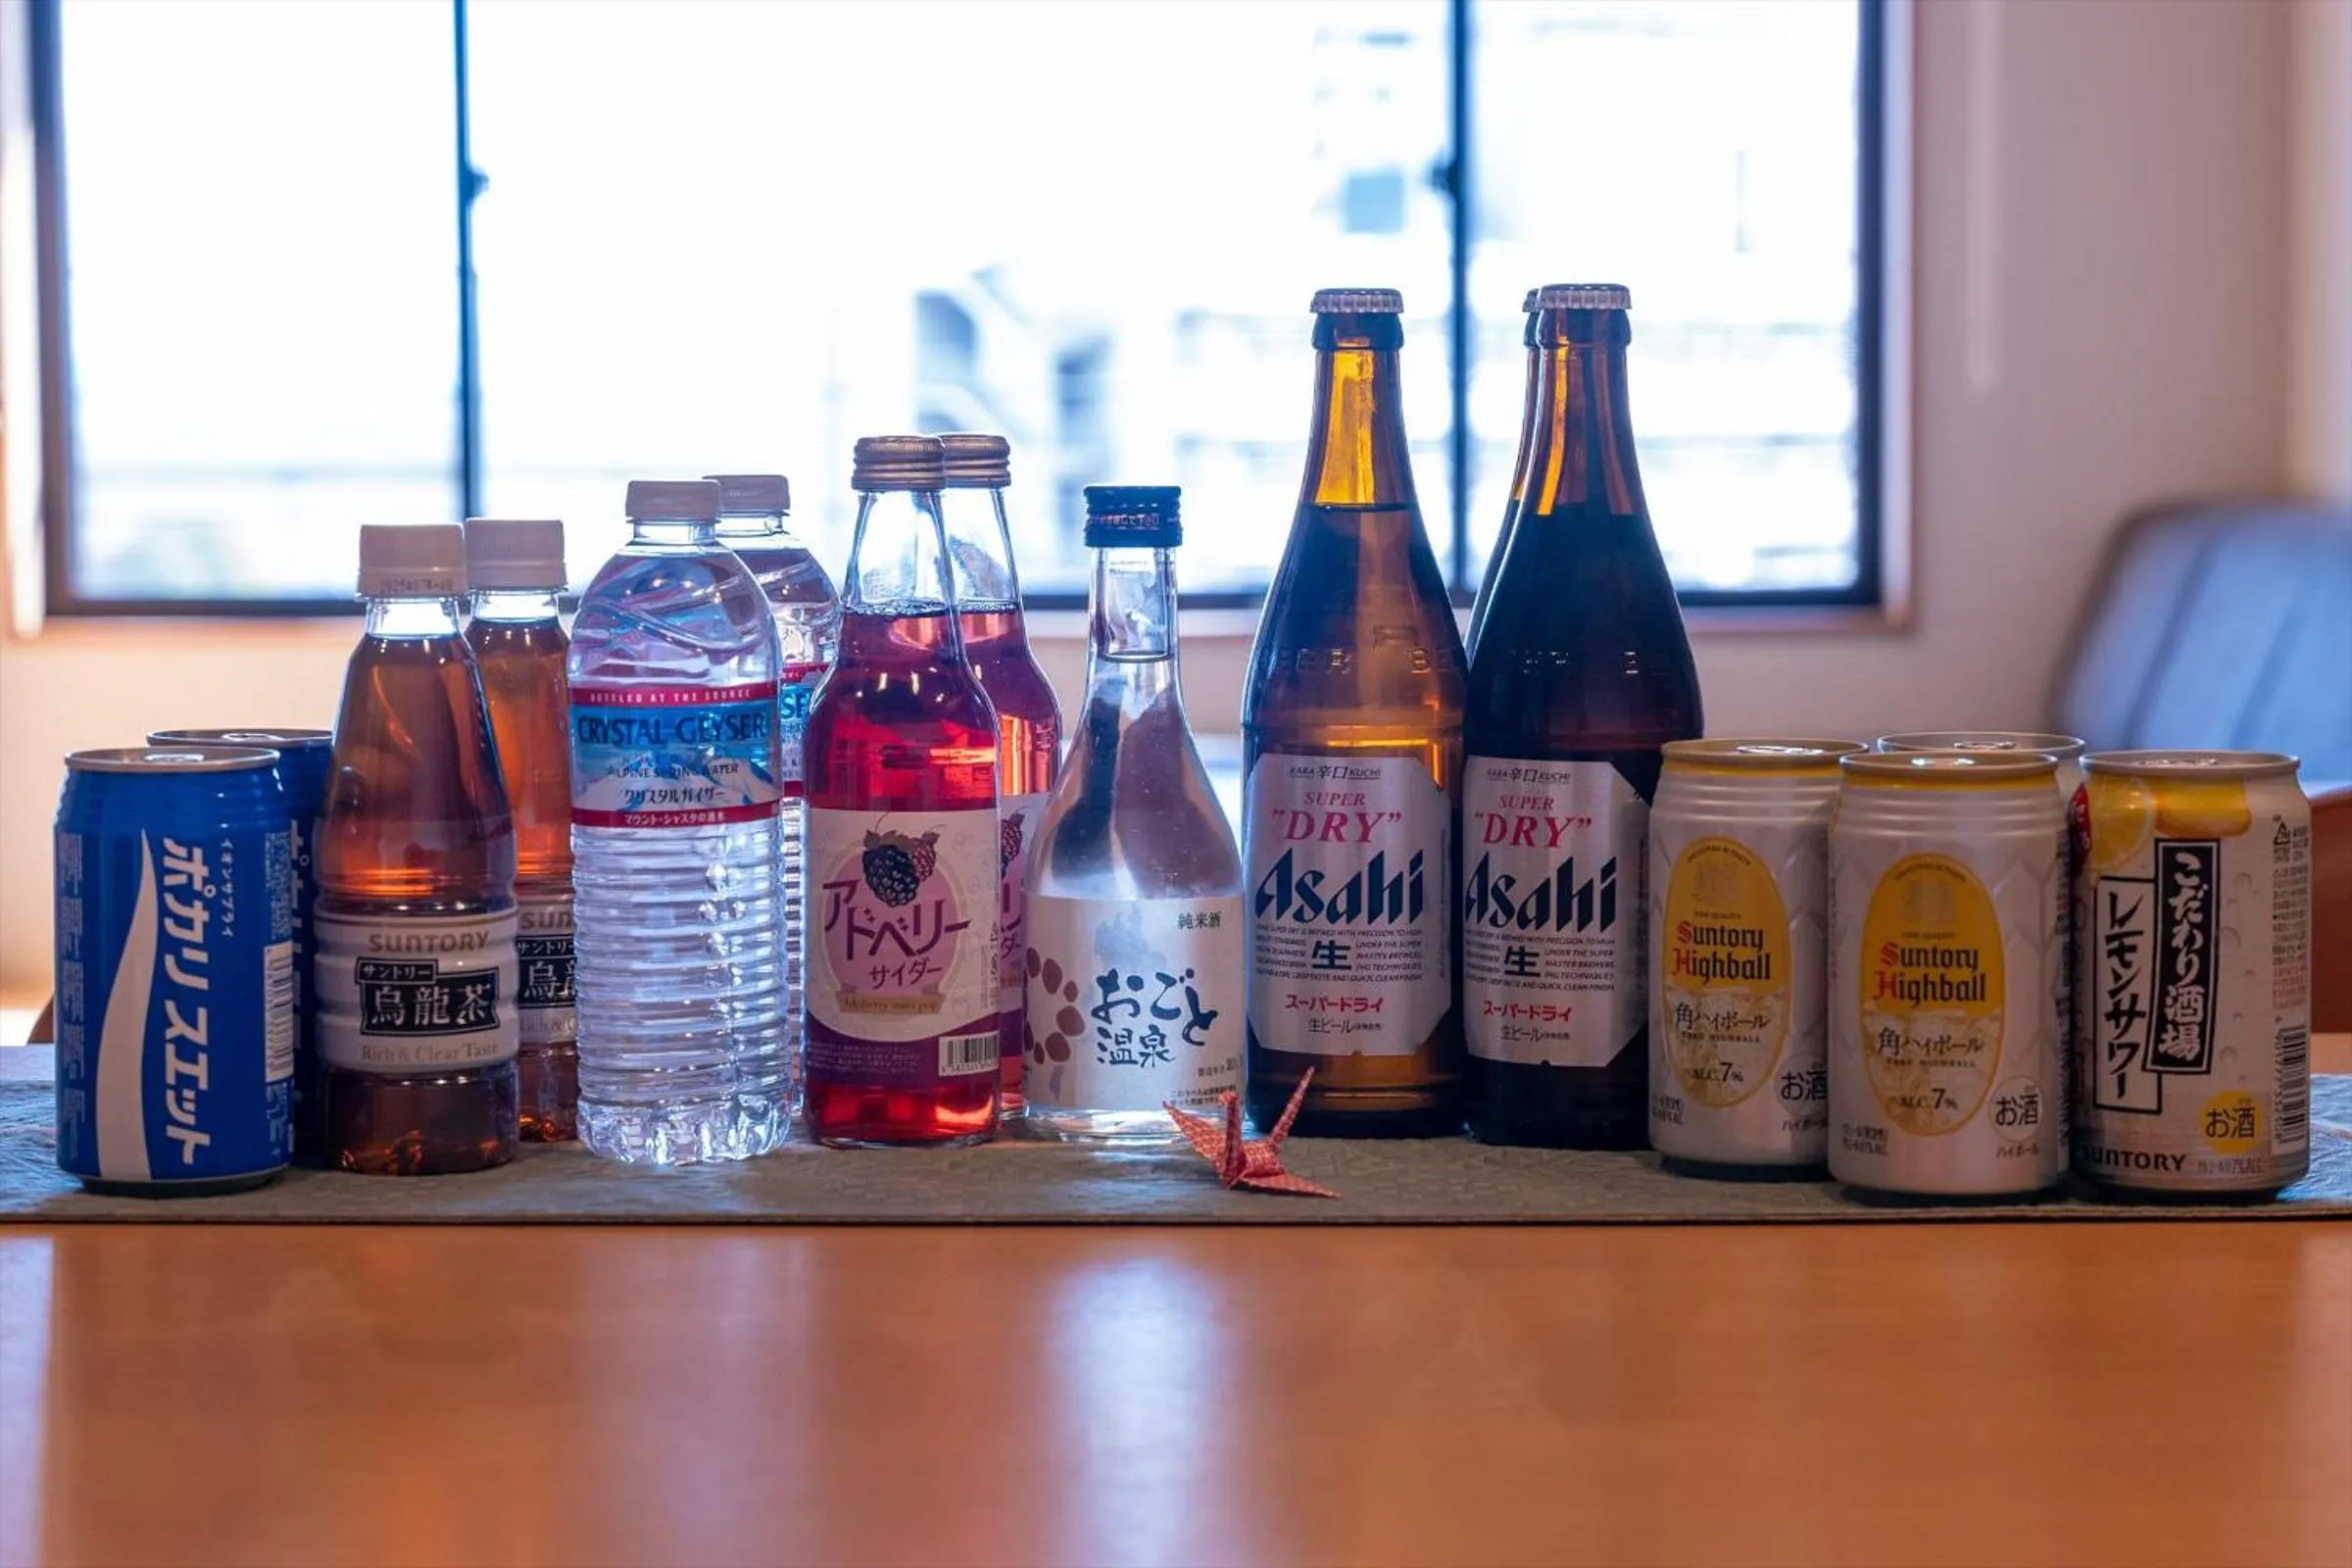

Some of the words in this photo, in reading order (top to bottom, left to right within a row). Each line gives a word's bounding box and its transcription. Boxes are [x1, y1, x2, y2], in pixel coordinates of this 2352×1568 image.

[577, 715, 666, 748] CRYSTAL
[675, 710, 765, 745] GEYSER
[624, 787, 726, 805] クリスタルガイザー
[1302, 791, 1366, 807] SUPER
[1500, 795, 1555, 810] SUPER
[220, 837, 234, 938] イオンサプライ
[1254, 848, 1424, 924] Asahi
[1464, 851, 1617, 932] Asahi
[822, 879, 971, 960] アドベリー
[1176, 911, 1221, 930] 純米酒
[368, 930, 490, 954] SUNTORY
[1675, 919, 1765, 955] Suntory
[1311, 939, 1352, 970] 生
[1504, 945, 1542, 978] 生
[1672, 946, 1772, 986] Highball
[1881, 942, 1978, 974] Suntory
[2159, 852, 2207, 1060] こだわり酒場
[362, 965, 432, 981] サントリー
[868, 956, 943, 990] サイダー
[1872, 970, 1986, 1007] Highball
[163, 836, 217, 1164] ポカリスエット
[370, 983, 492, 1026] 烏龍茶
[1091, 967, 1219, 1047] おごと
[1284, 993, 1385, 1013] スーパードライ
[1483, 1000, 1573, 1022] スーパードライ
[2104, 890, 2147, 1099] レモンサワー
[1676, 1002, 1771, 1032] 角ハイボール
[1097, 1024, 1176, 1068] 温泉
[1878, 1027, 1984, 1055] 角ハイボール
[1780, 1069, 1827, 1102] お酒
[1995, 1093, 2039, 1126] お酒
[2205, 1105, 2255, 1139] お酒
